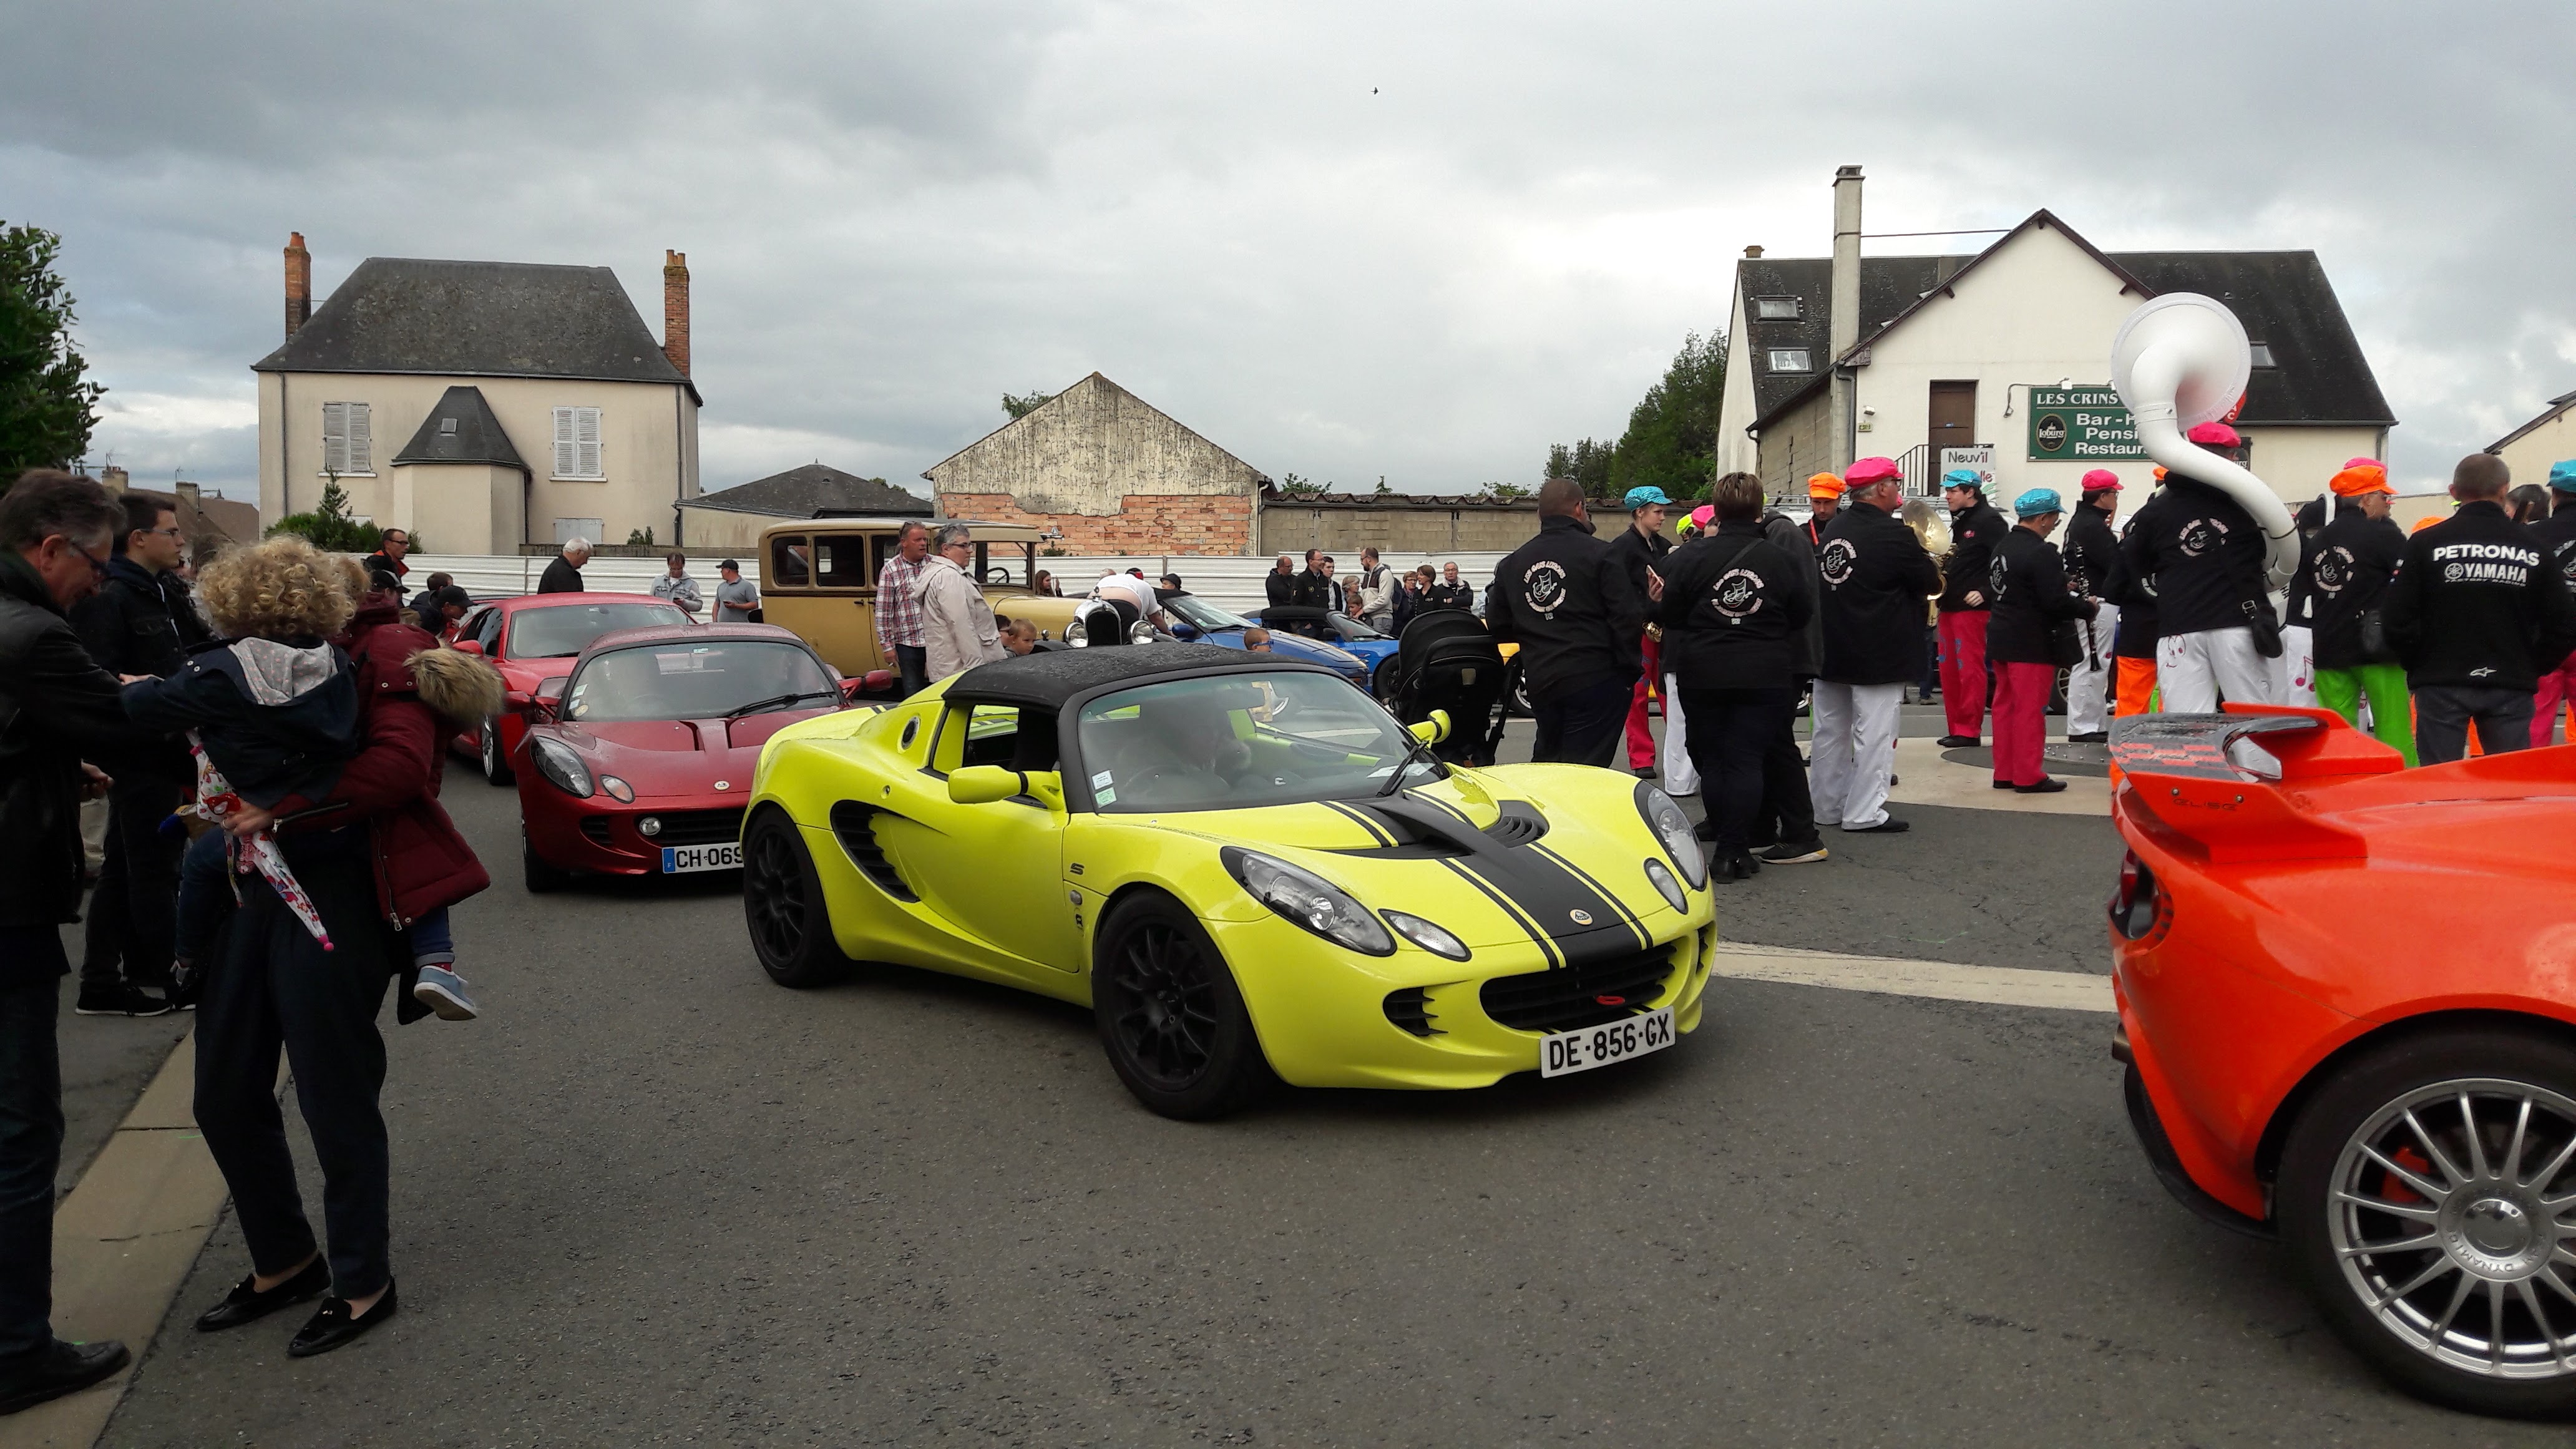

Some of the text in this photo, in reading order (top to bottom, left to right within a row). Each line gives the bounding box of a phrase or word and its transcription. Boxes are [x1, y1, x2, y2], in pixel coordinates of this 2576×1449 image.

[2036, 393, 2119, 404] LES CRINS
[2086, 427, 2139, 439] Pensi
[2075, 442, 2148, 454] Restaur
[2433, 544, 2540, 567] PETRONAS
[2465, 563, 2527, 583] YAMAHA
[2492, 579, 2527, 587] RACING
[676, 846, 743, 868] CH-069
[1070, 863, 1085, 875] S
